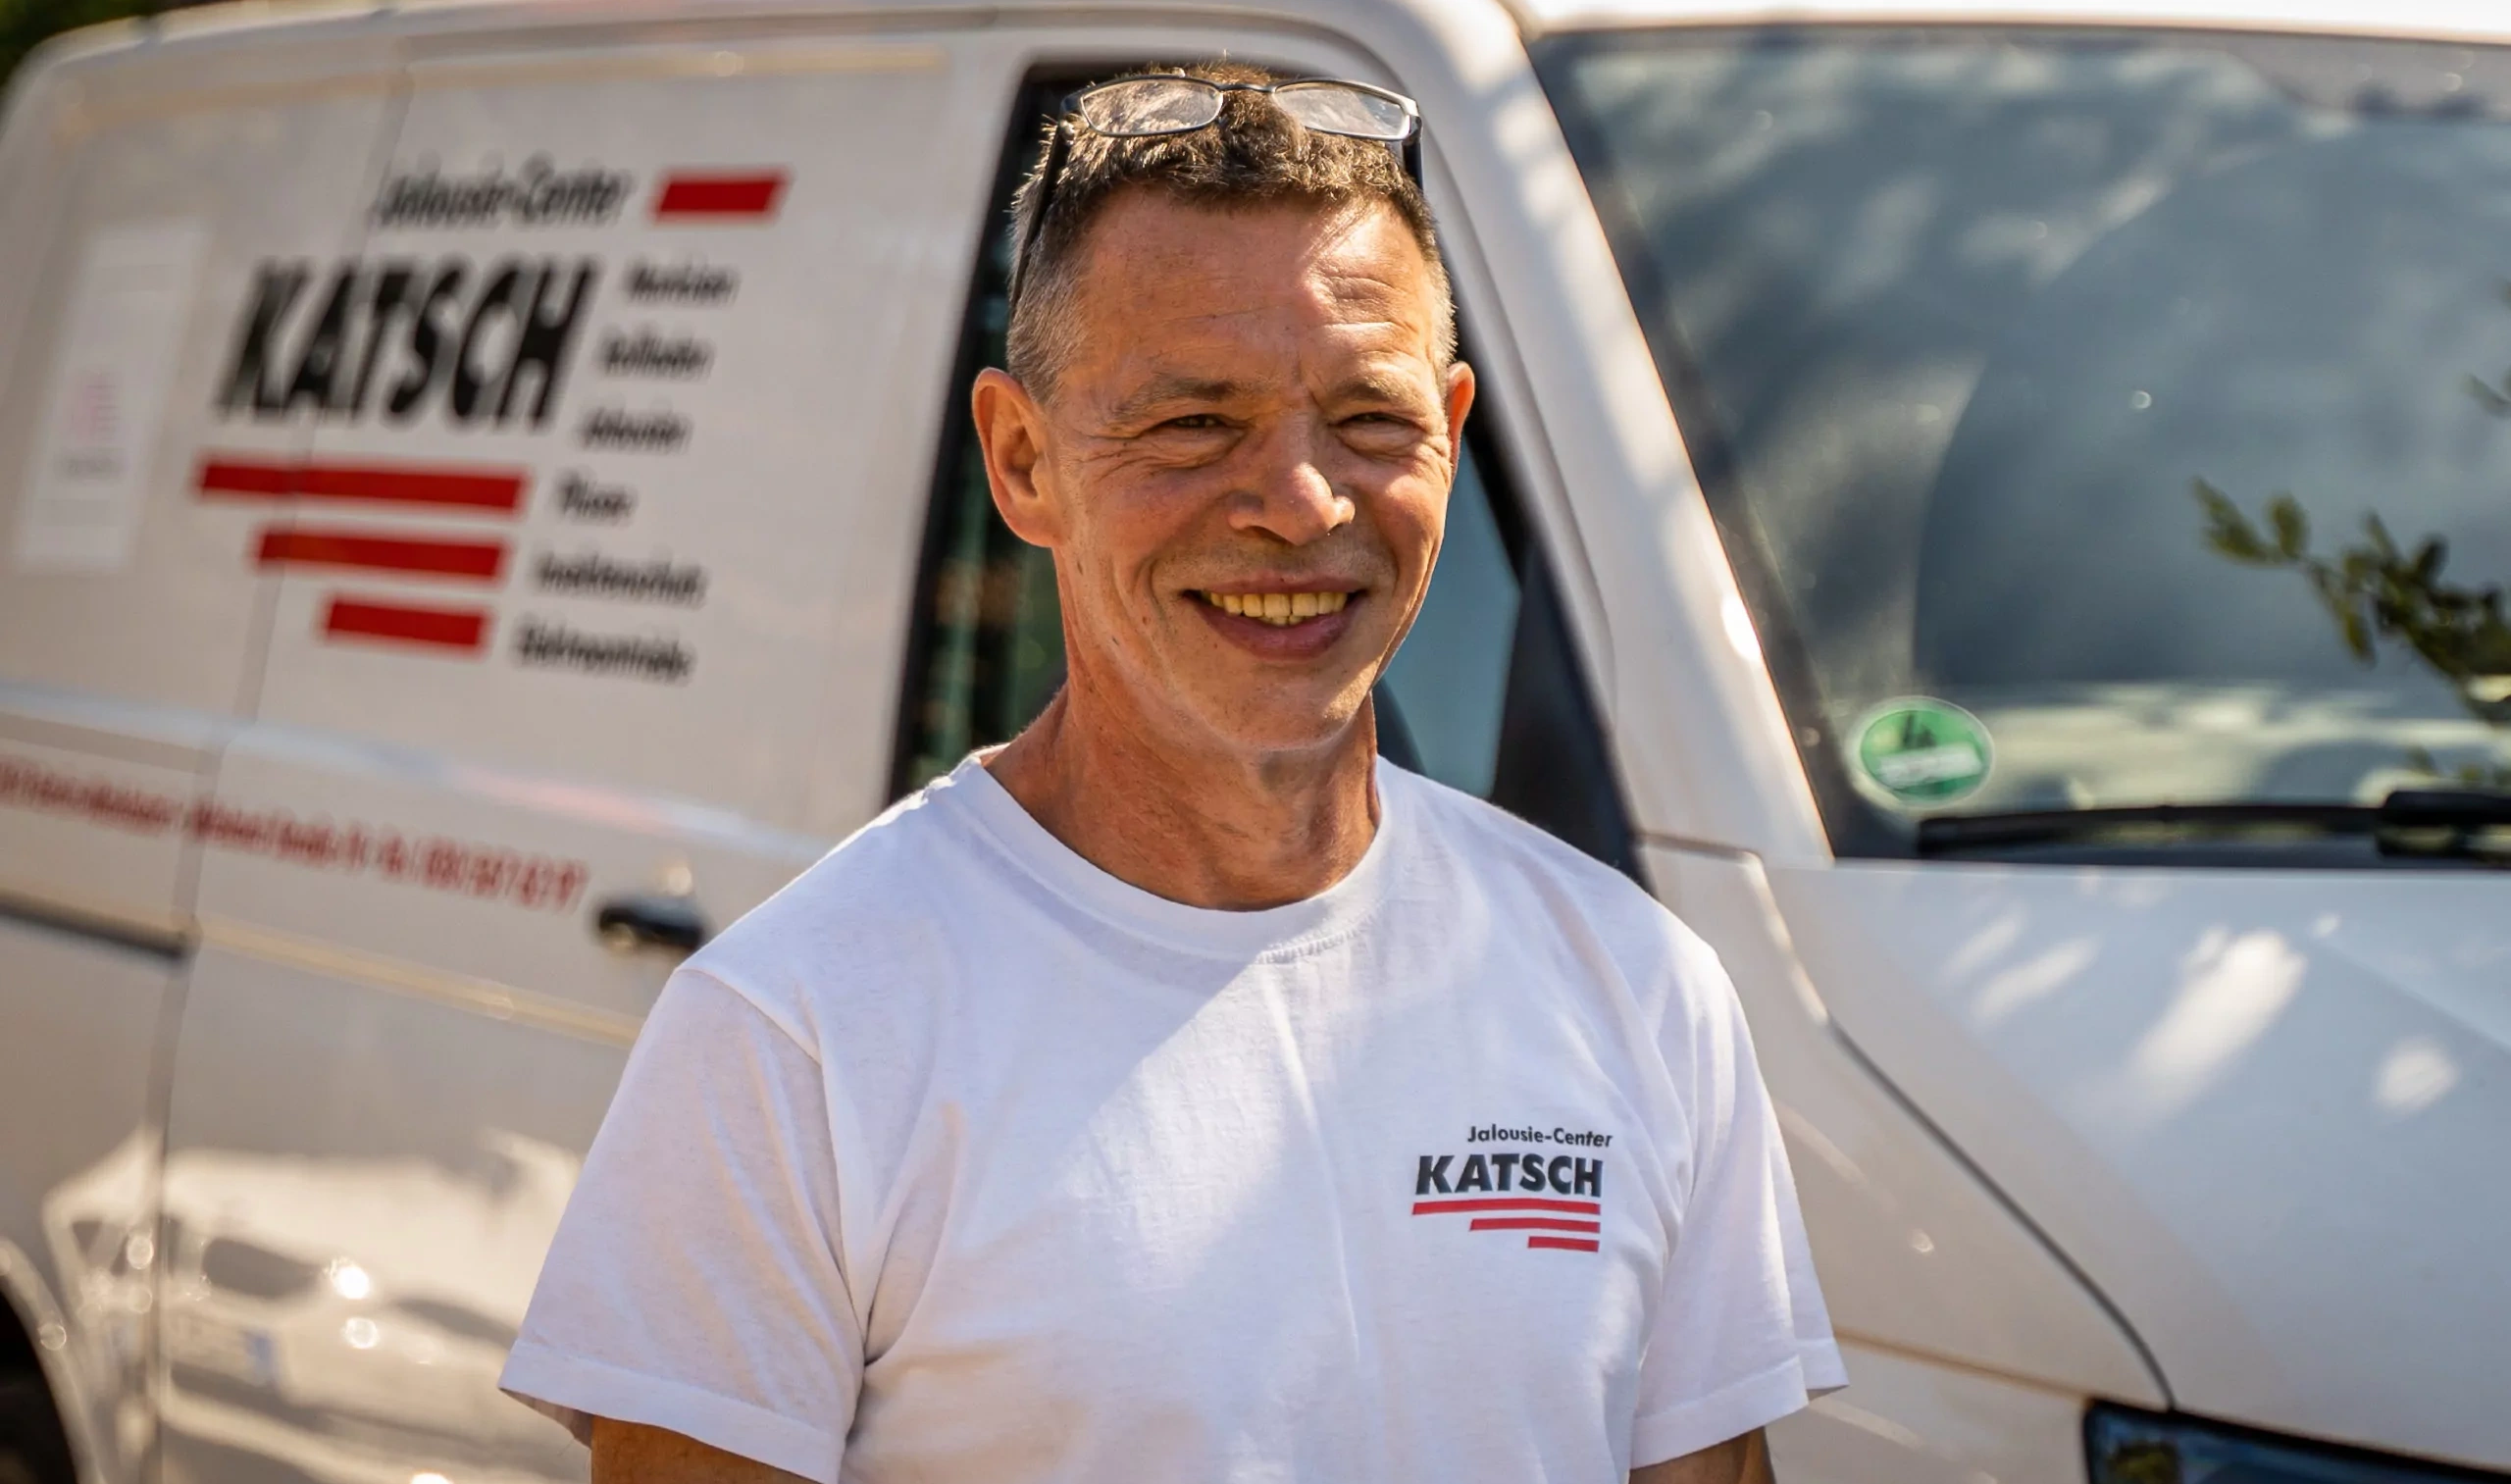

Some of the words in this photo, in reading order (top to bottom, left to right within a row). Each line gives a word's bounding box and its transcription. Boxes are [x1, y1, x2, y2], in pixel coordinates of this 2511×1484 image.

[218, 255, 600, 431] KATSCH
[1467, 1123, 1613, 1148] Jalousie-Center
[1414, 1152, 1604, 1198] KATSCH
